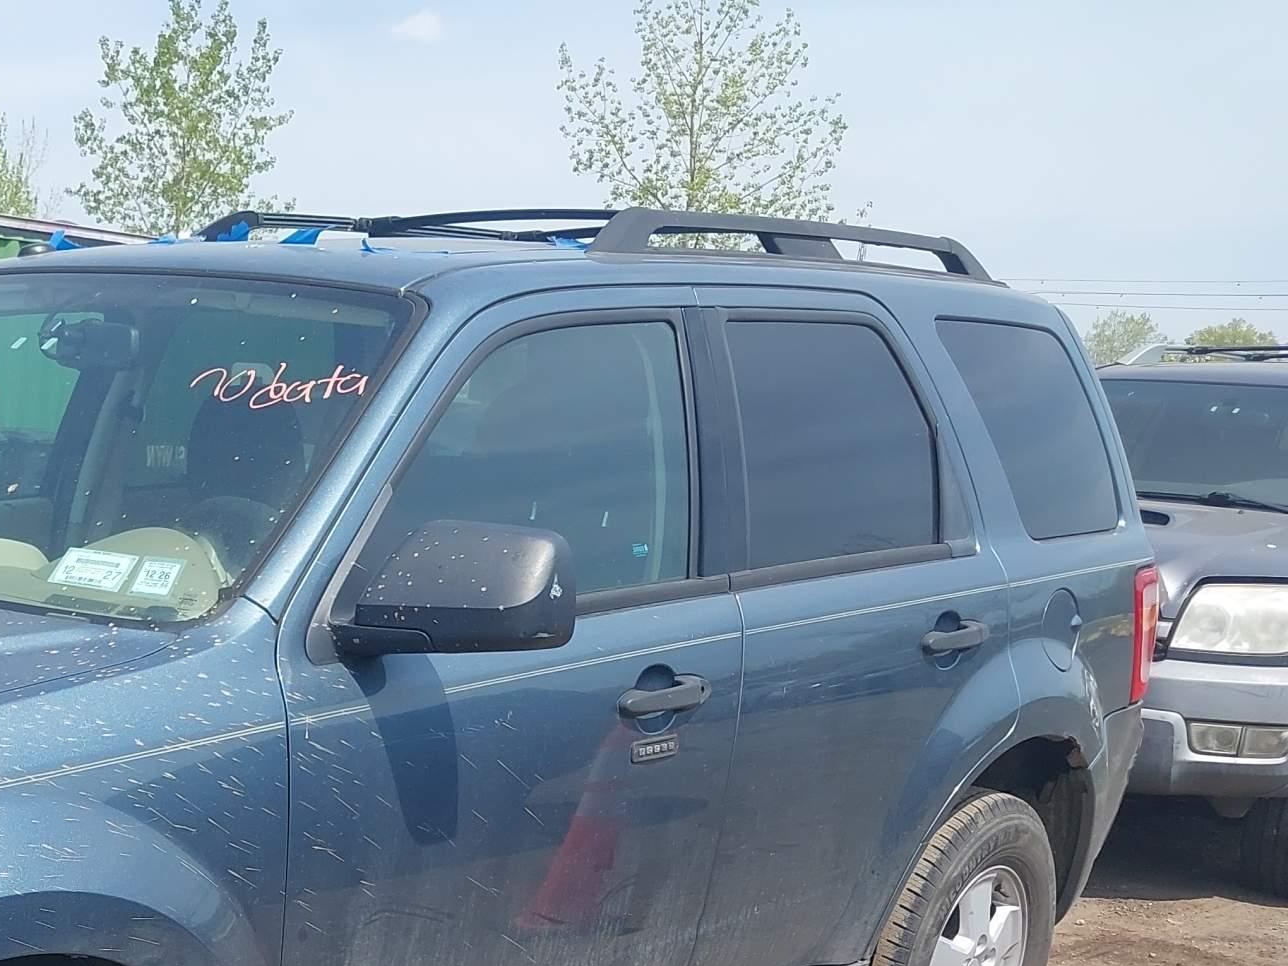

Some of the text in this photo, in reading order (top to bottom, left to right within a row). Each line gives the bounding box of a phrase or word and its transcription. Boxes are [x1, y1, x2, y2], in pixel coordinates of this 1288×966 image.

[248, 362, 369, 410] data
[62, 564, 75, 575] 12
[103, 570, 122, 581] 27
